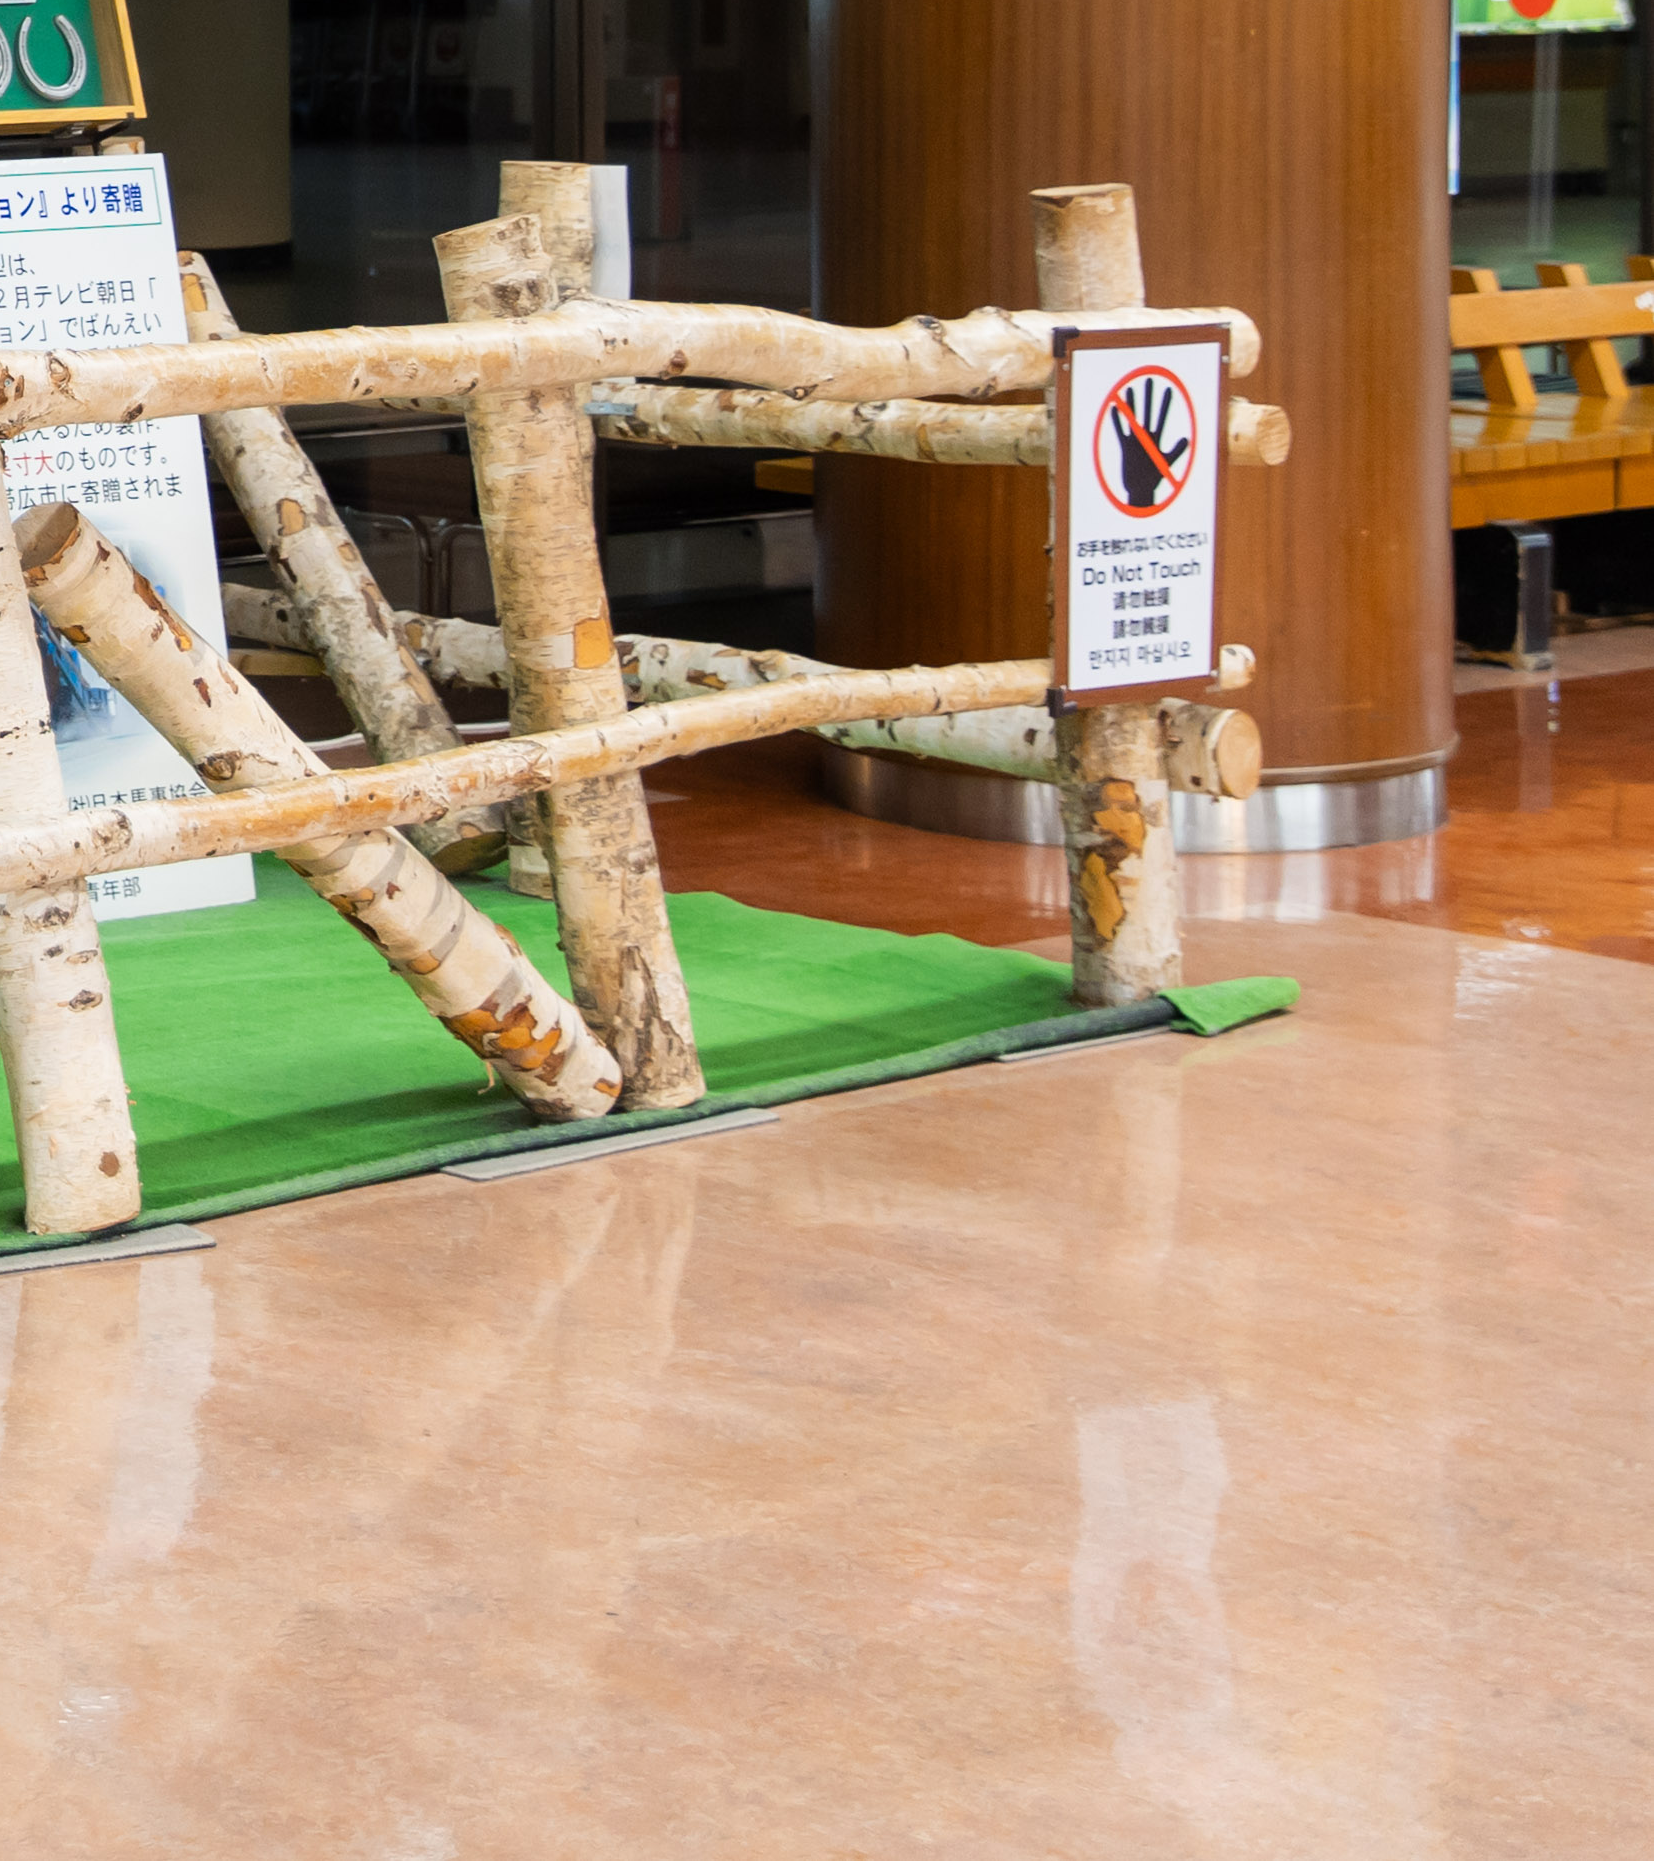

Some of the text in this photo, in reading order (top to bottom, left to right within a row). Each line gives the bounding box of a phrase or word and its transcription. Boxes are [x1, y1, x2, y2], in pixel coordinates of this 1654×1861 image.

[1082, 558, 1201, 587] Do Not Touch
